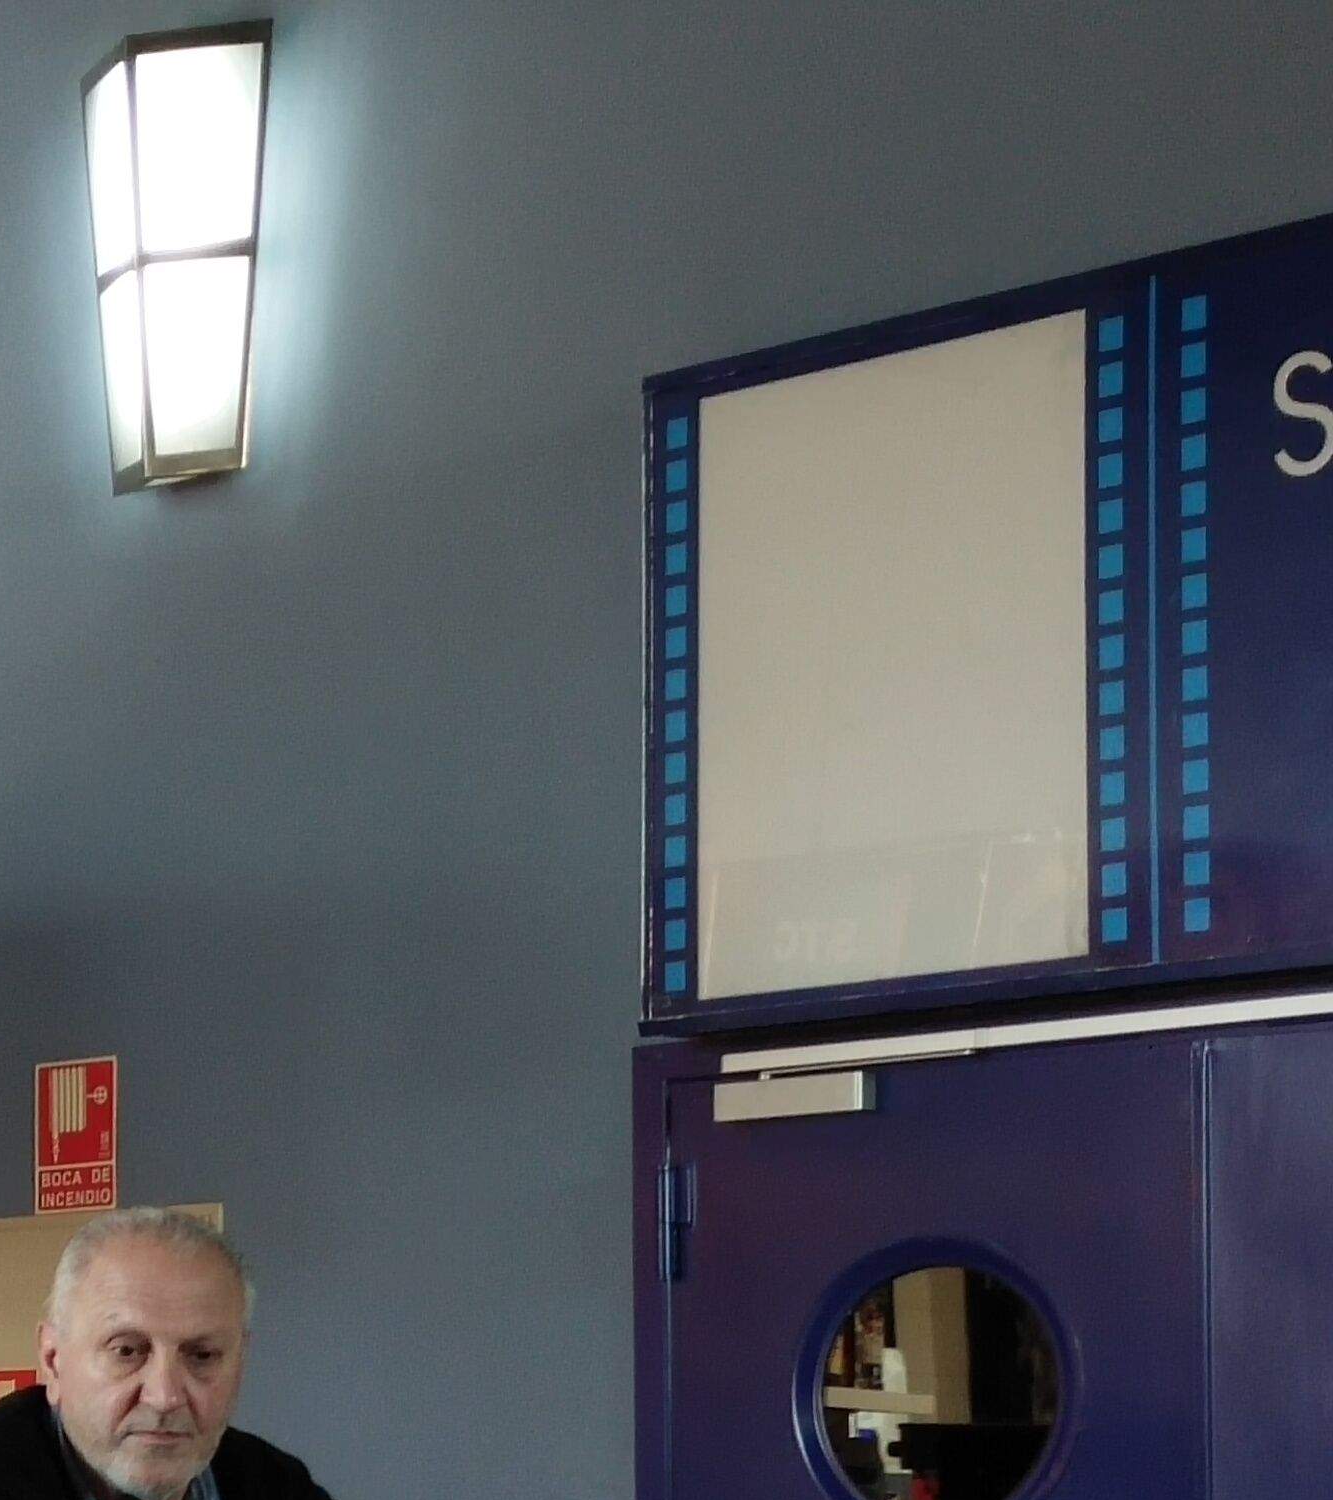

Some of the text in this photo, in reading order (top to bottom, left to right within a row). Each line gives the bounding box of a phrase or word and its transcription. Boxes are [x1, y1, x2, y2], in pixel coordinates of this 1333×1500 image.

[1273, 350, 1333, 477] S
[41, 1167, 111, 1188] BOCA DE
[41, 1188, 111, 1207] INCENDIO
